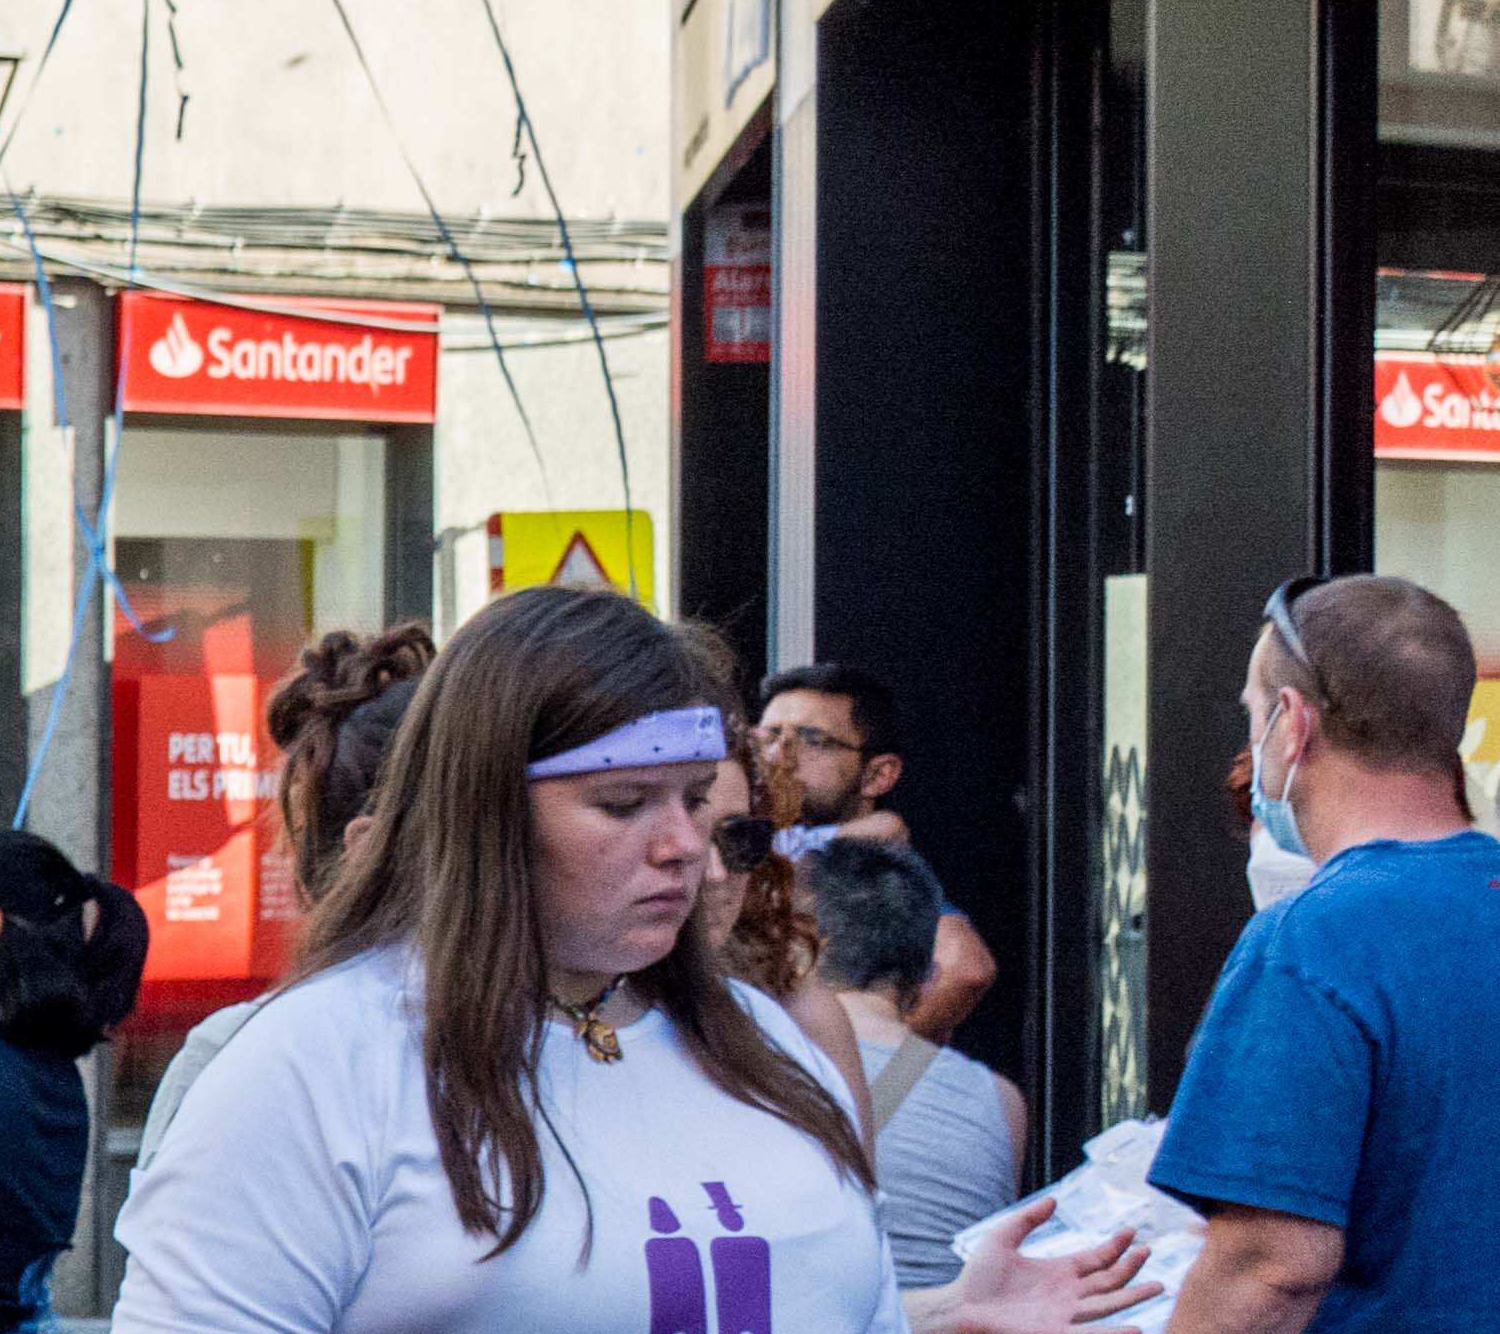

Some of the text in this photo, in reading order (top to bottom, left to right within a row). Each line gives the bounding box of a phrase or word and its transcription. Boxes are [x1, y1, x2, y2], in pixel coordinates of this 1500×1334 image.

[207, 326, 413, 387] Santander
[168, 731, 257, 768] PER TU,
[168, 769, 209, 800] ELS
